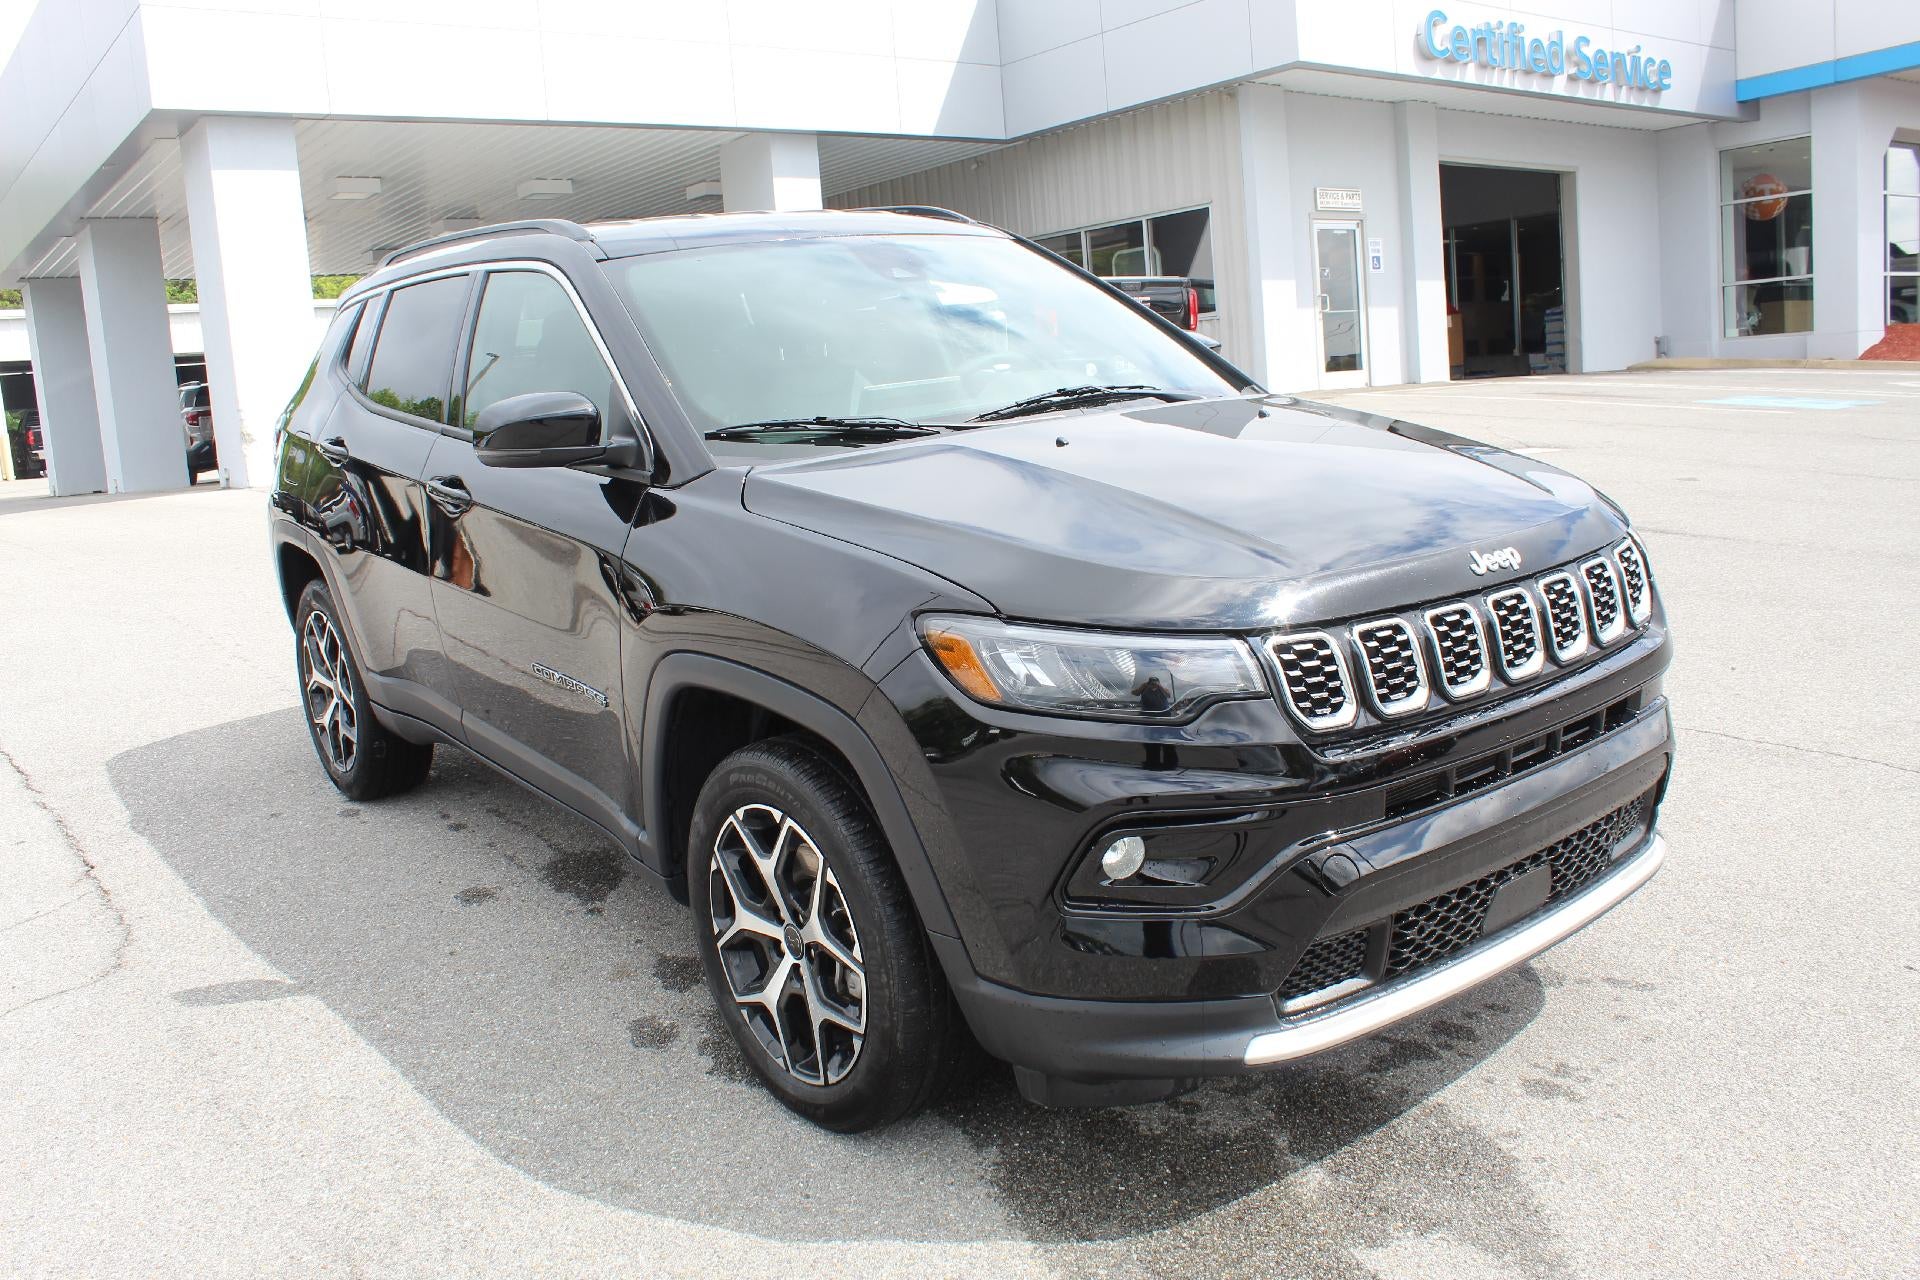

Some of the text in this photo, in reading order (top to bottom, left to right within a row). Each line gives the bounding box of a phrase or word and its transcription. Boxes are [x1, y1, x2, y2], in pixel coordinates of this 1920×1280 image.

[1424, 9, 1673, 91] Certified Service
[1319, 191, 1340, 201] SERVICE
[1345, 192, 1361, 201] PARTS
[1468, 546, 1522, 576] Jeep
[531, 662, 608, 708] COMPASS
